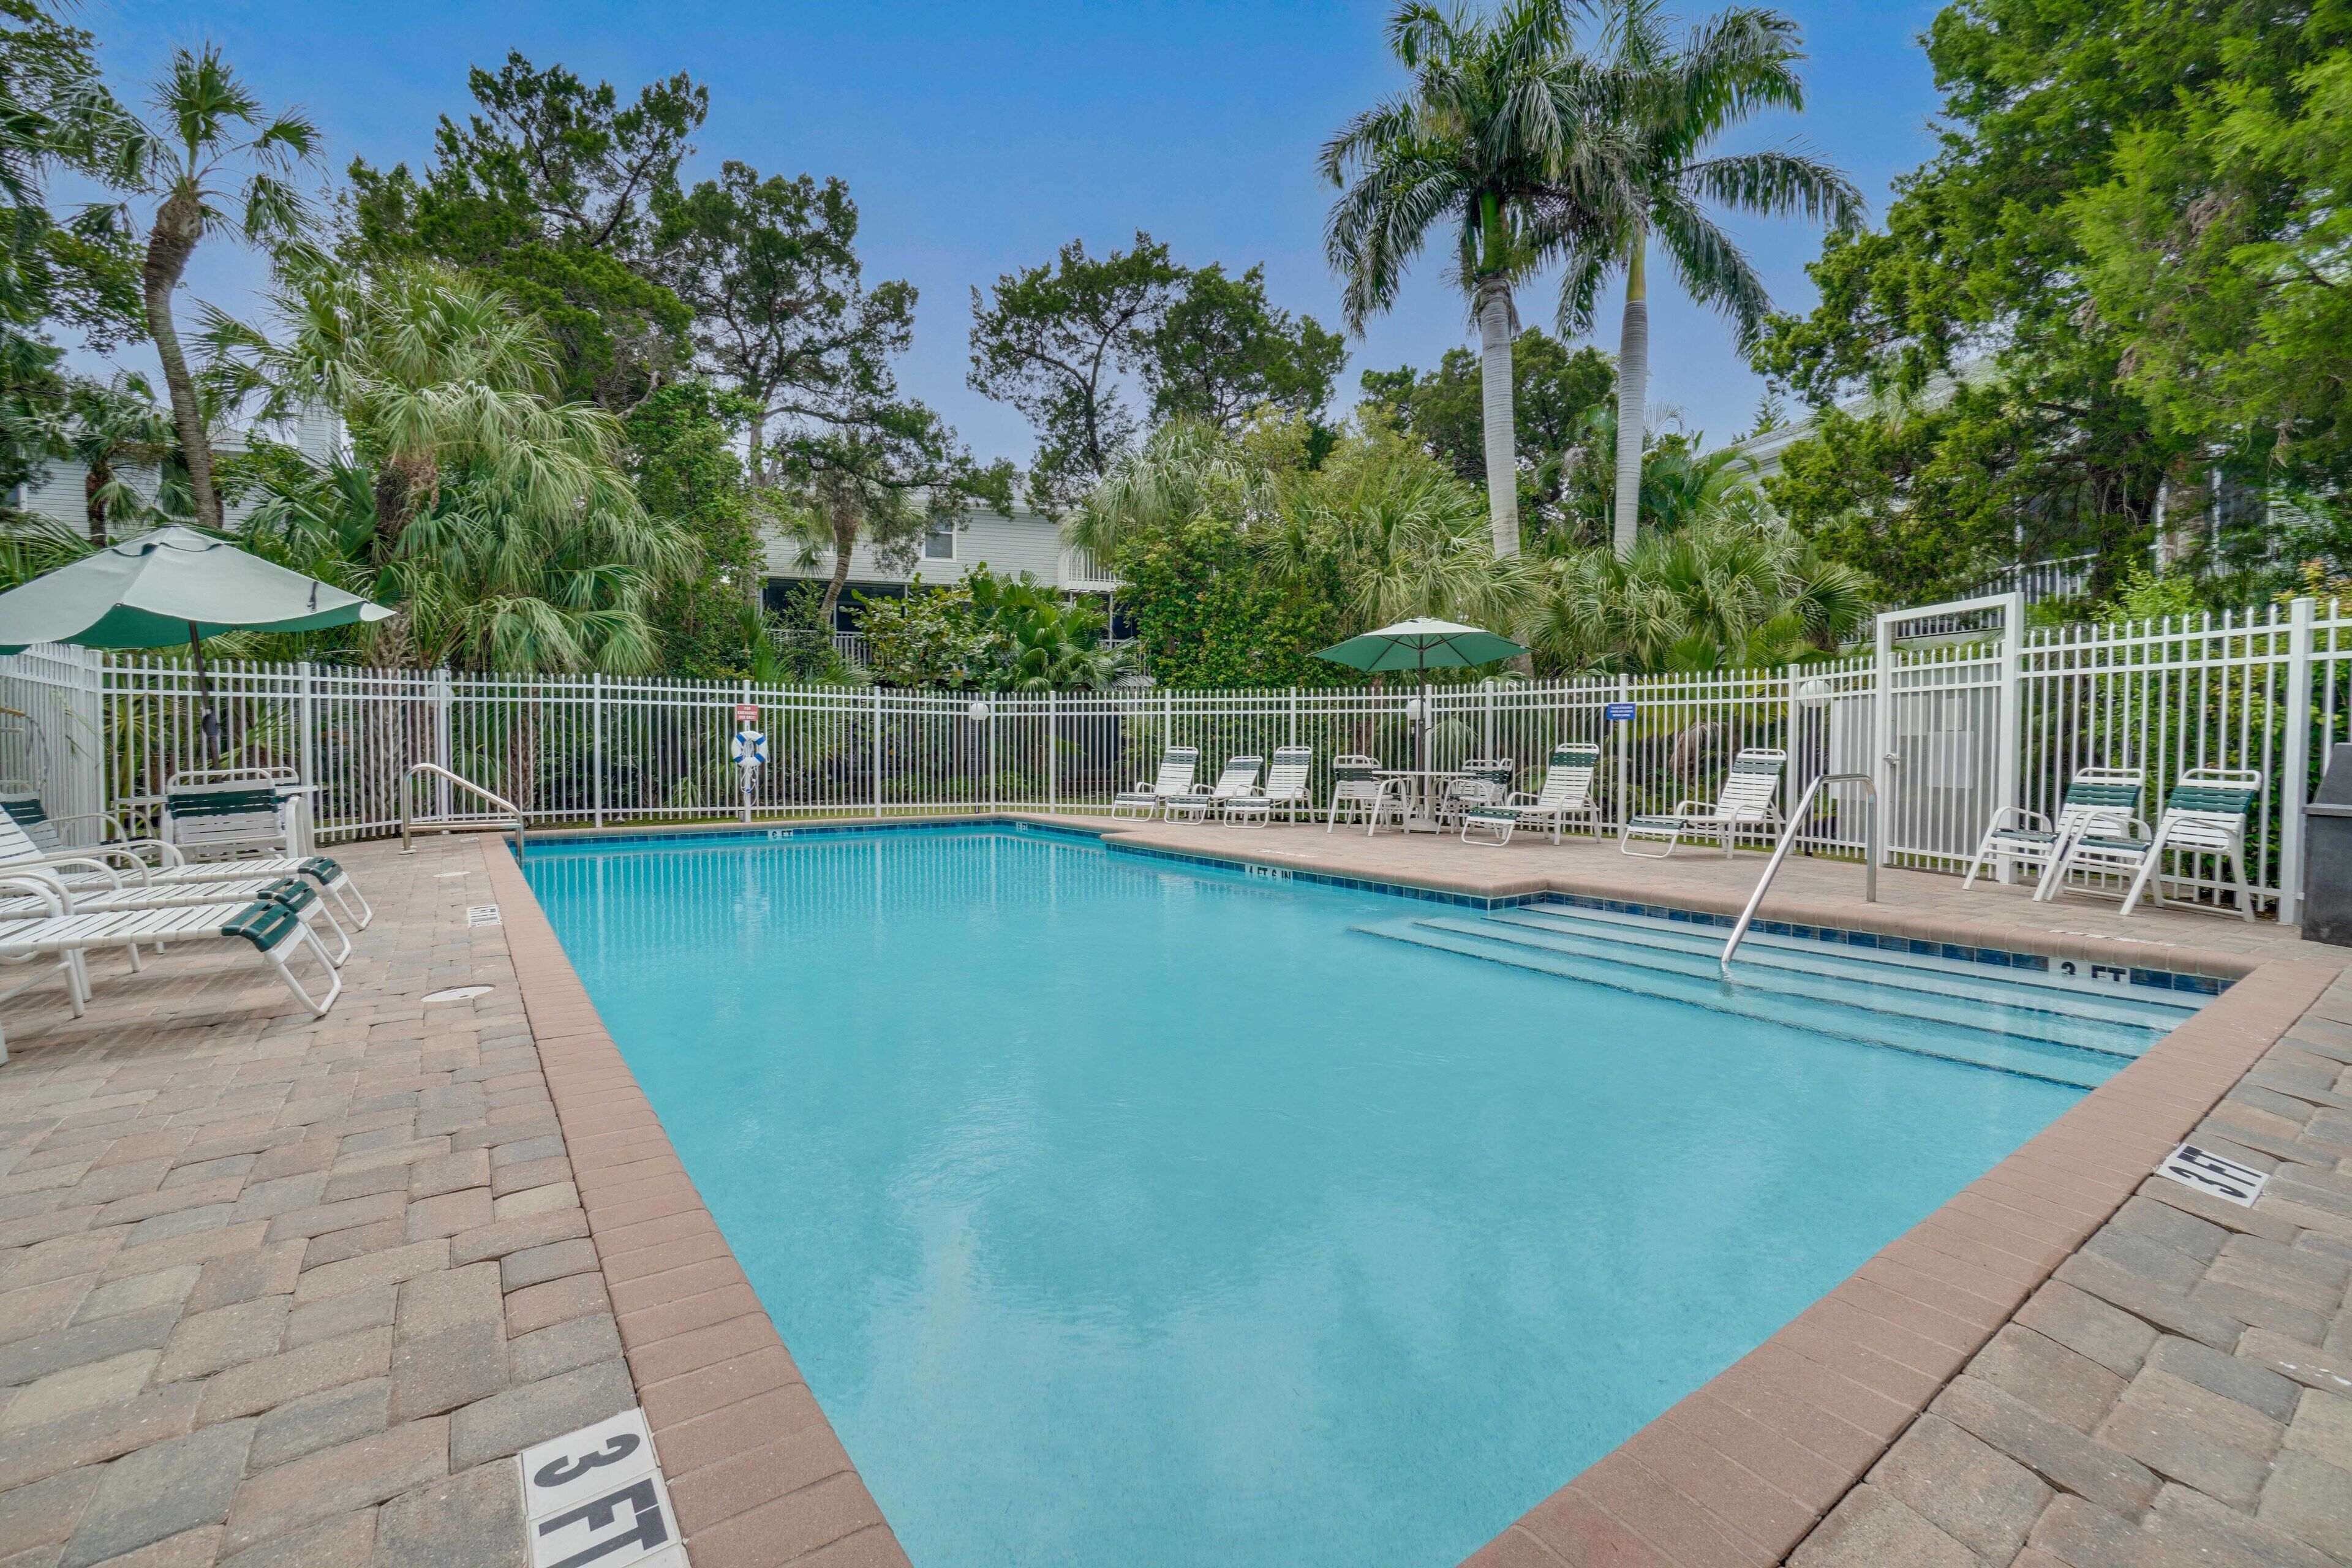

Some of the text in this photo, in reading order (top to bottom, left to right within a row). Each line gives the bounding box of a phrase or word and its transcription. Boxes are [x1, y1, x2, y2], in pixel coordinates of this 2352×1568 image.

[1257, 867, 1268, 875] FT
[1281, 870, 1291, 879] IN
[2091, 964, 2127, 982] FT
[2168, 1145, 2262, 1199] 3 FT
[533, 1433, 669, 1568] 3 FT
